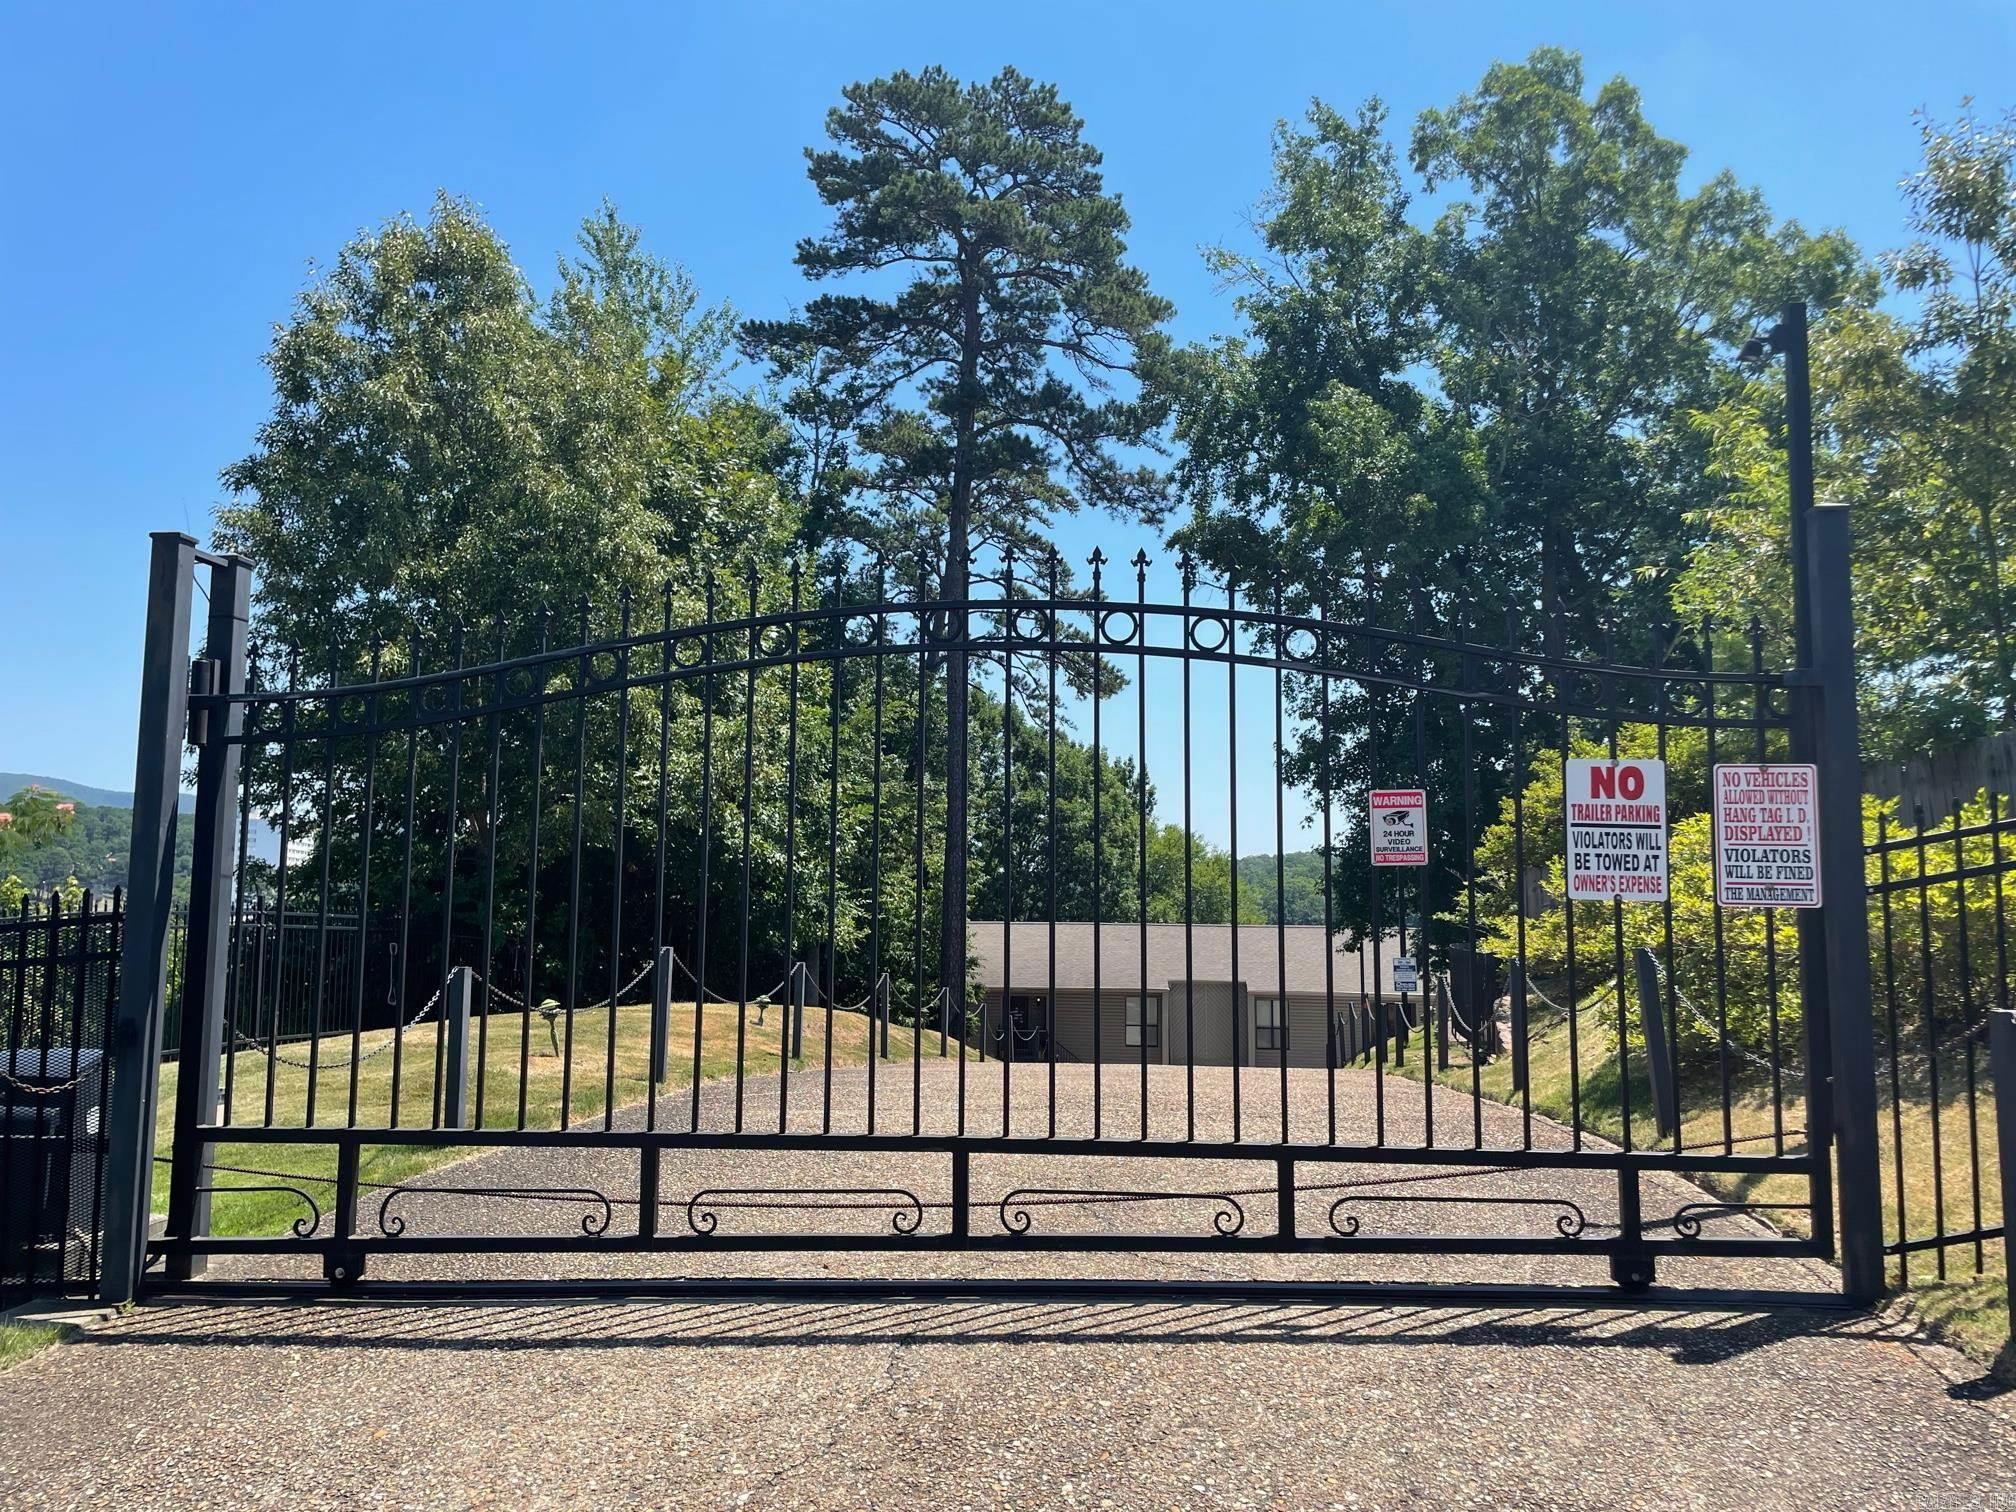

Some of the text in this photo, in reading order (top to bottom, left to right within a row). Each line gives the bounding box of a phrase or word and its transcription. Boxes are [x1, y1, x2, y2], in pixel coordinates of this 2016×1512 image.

[1590, 765, 1645, 800] NO
[1722, 772, 1808, 788] NO VEHICLES
[1373, 796, 1422, 806] WARNING
[1723, 790, 1808, 805] ALLOWED WITHOUT
[1571, 804, 1660, 823] TRAILER PARKING
[1723, 807, 1756, 823] HANG
[1759, 808, 1783, 823] TAG
[1572, 831, 1661, 850] VIOLATORS WILL
[1575, 852, 1660, 872] BE TOWED AT
[1724, 848, 1811, 864] VIOLATORS
[1724, 865, 1814, 880] WILL BE FINED
[1573, 874, 1662, 894] OWNER'S EXPENSE
[1724, 887, 1814, 902] THE MANAGEMENT
